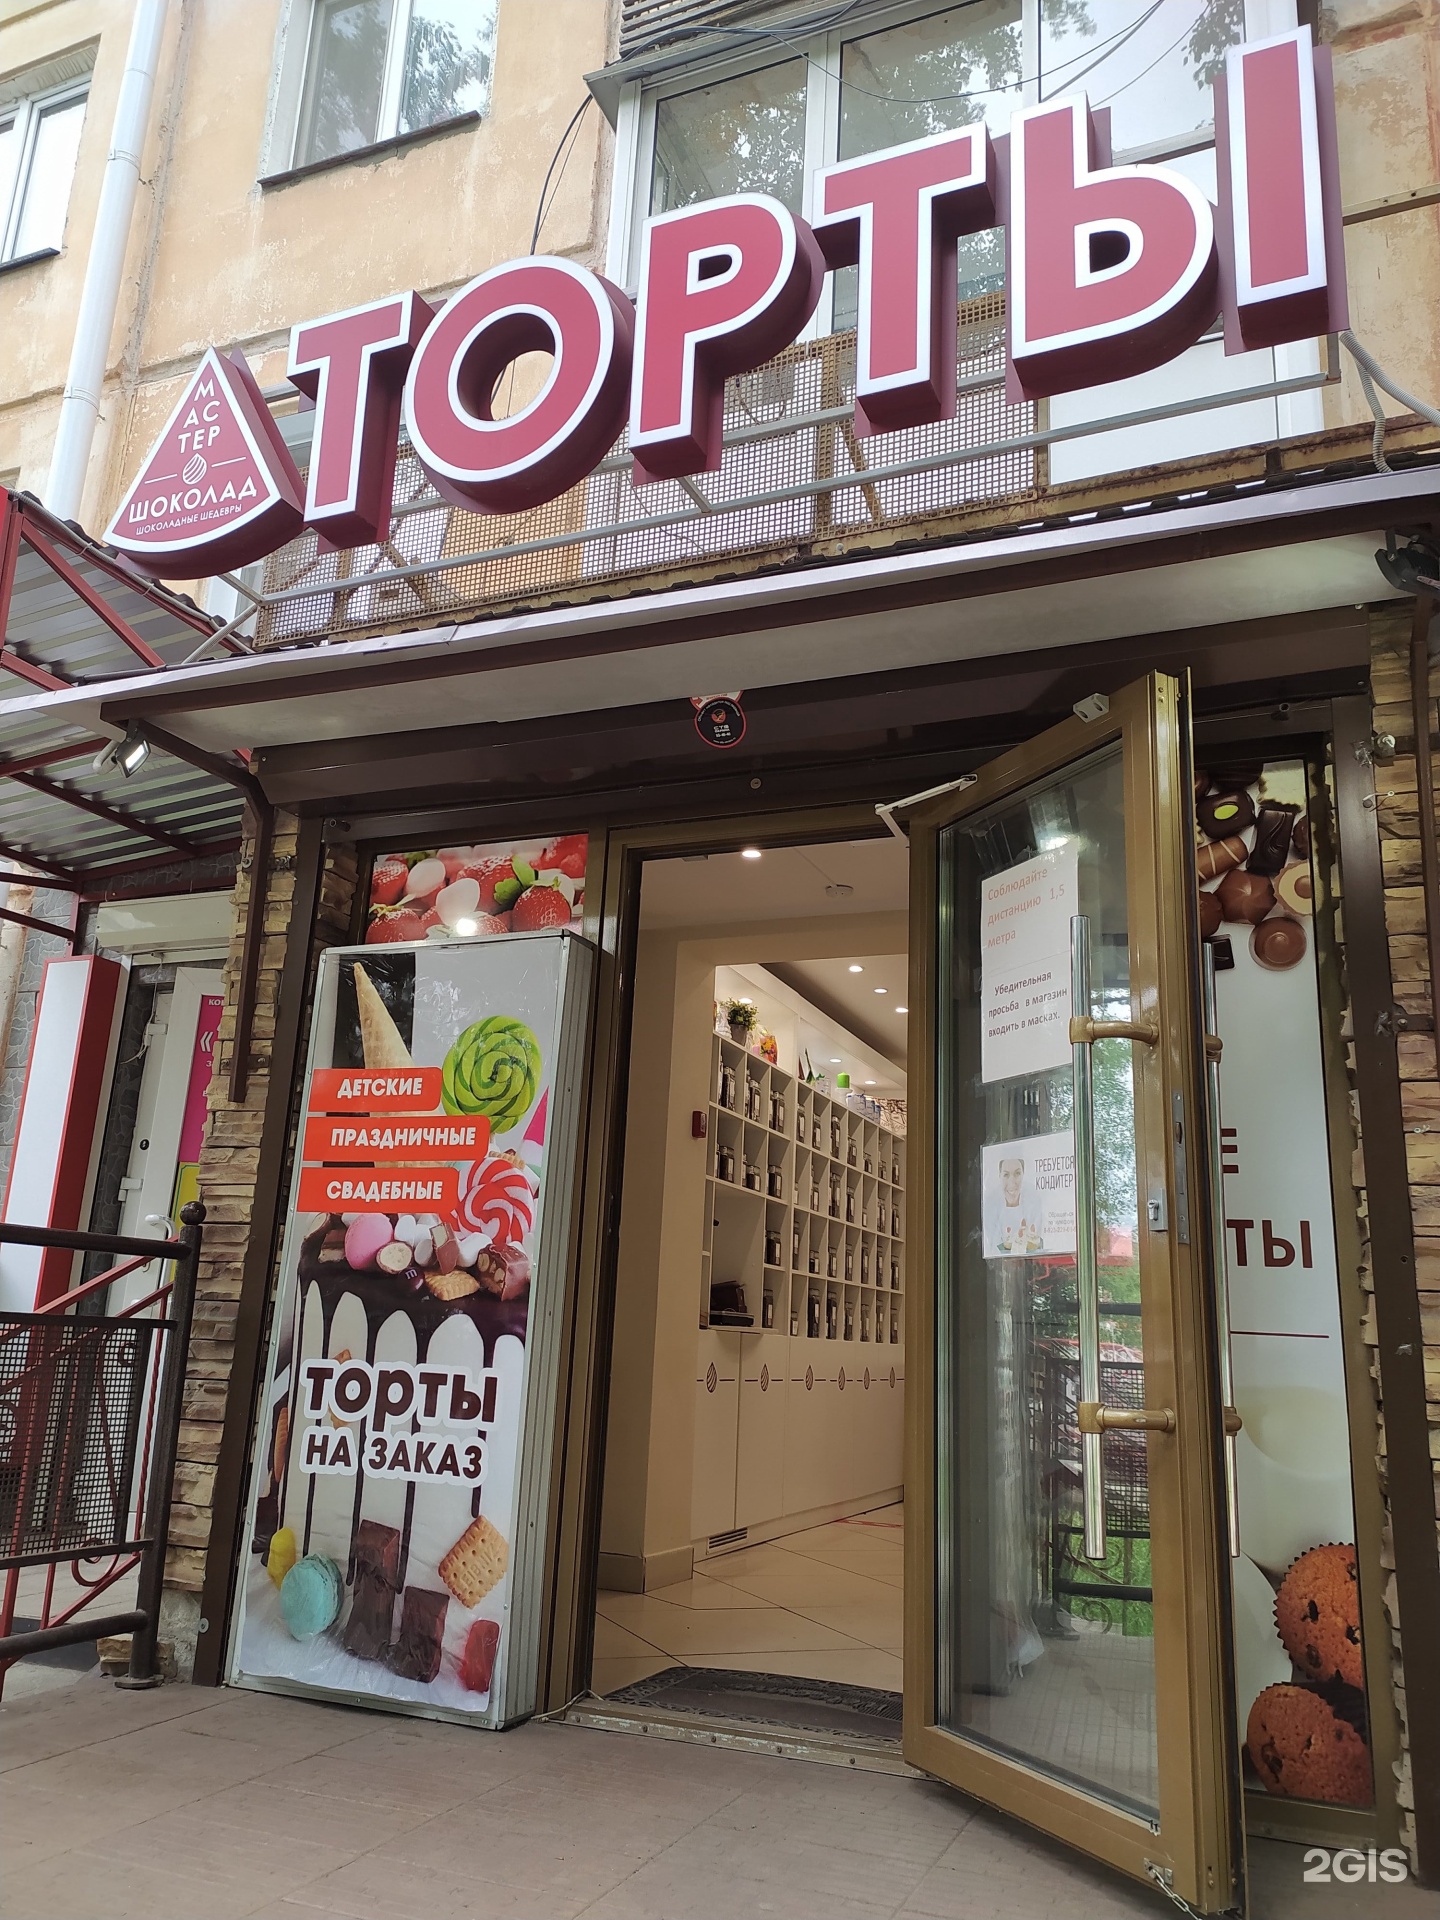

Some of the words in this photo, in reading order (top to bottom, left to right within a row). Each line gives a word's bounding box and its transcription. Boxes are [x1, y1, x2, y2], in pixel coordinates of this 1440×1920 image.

[288, 25, 1332, 540] ТОРТЫ
[128, 475, 257, 523] ШОКОЛАД
[135, 516, 199, 536] ШОКОЛАДНЫЕ
[200, 503, 242, 521] ШЕДЕВРЫ
[988, 868, 1048, 900] Соблюдайте
[987, 895, 1041, 927] дистанцию
[1049, 884, 1065, 900] 1,5
[987, 929, 1016, 948] метра
[994, 972, 1052, 996] Убедительная
[988, 1000, 1020, 1019] просьба
[1025, 998, 1030, 1007] в
[1032, 988, 1067, 1005] магазин
[988, 1020, 1019, 1038] входить
[1021, 1020, 1026, 1029] в
[1027, 1011, 1061, 1027] масках.
[337, 1077, 423, 1099] ДЕТСКИЕ
[331, 1127, 477, 1149] ПРАЗДНИЧНЫЕ
[1035, 1155, 1075, 1173] ТРЕБУЕТСЯ
[326, 1181, 443, 1202] СВАДЕБНЫЕ
[1036, 1173, 1074, 1191] КОНДИТЕР
[306, 1434, 351, 1467] НА
[368, 1437, 482, 1479] ЗАКАЗ
